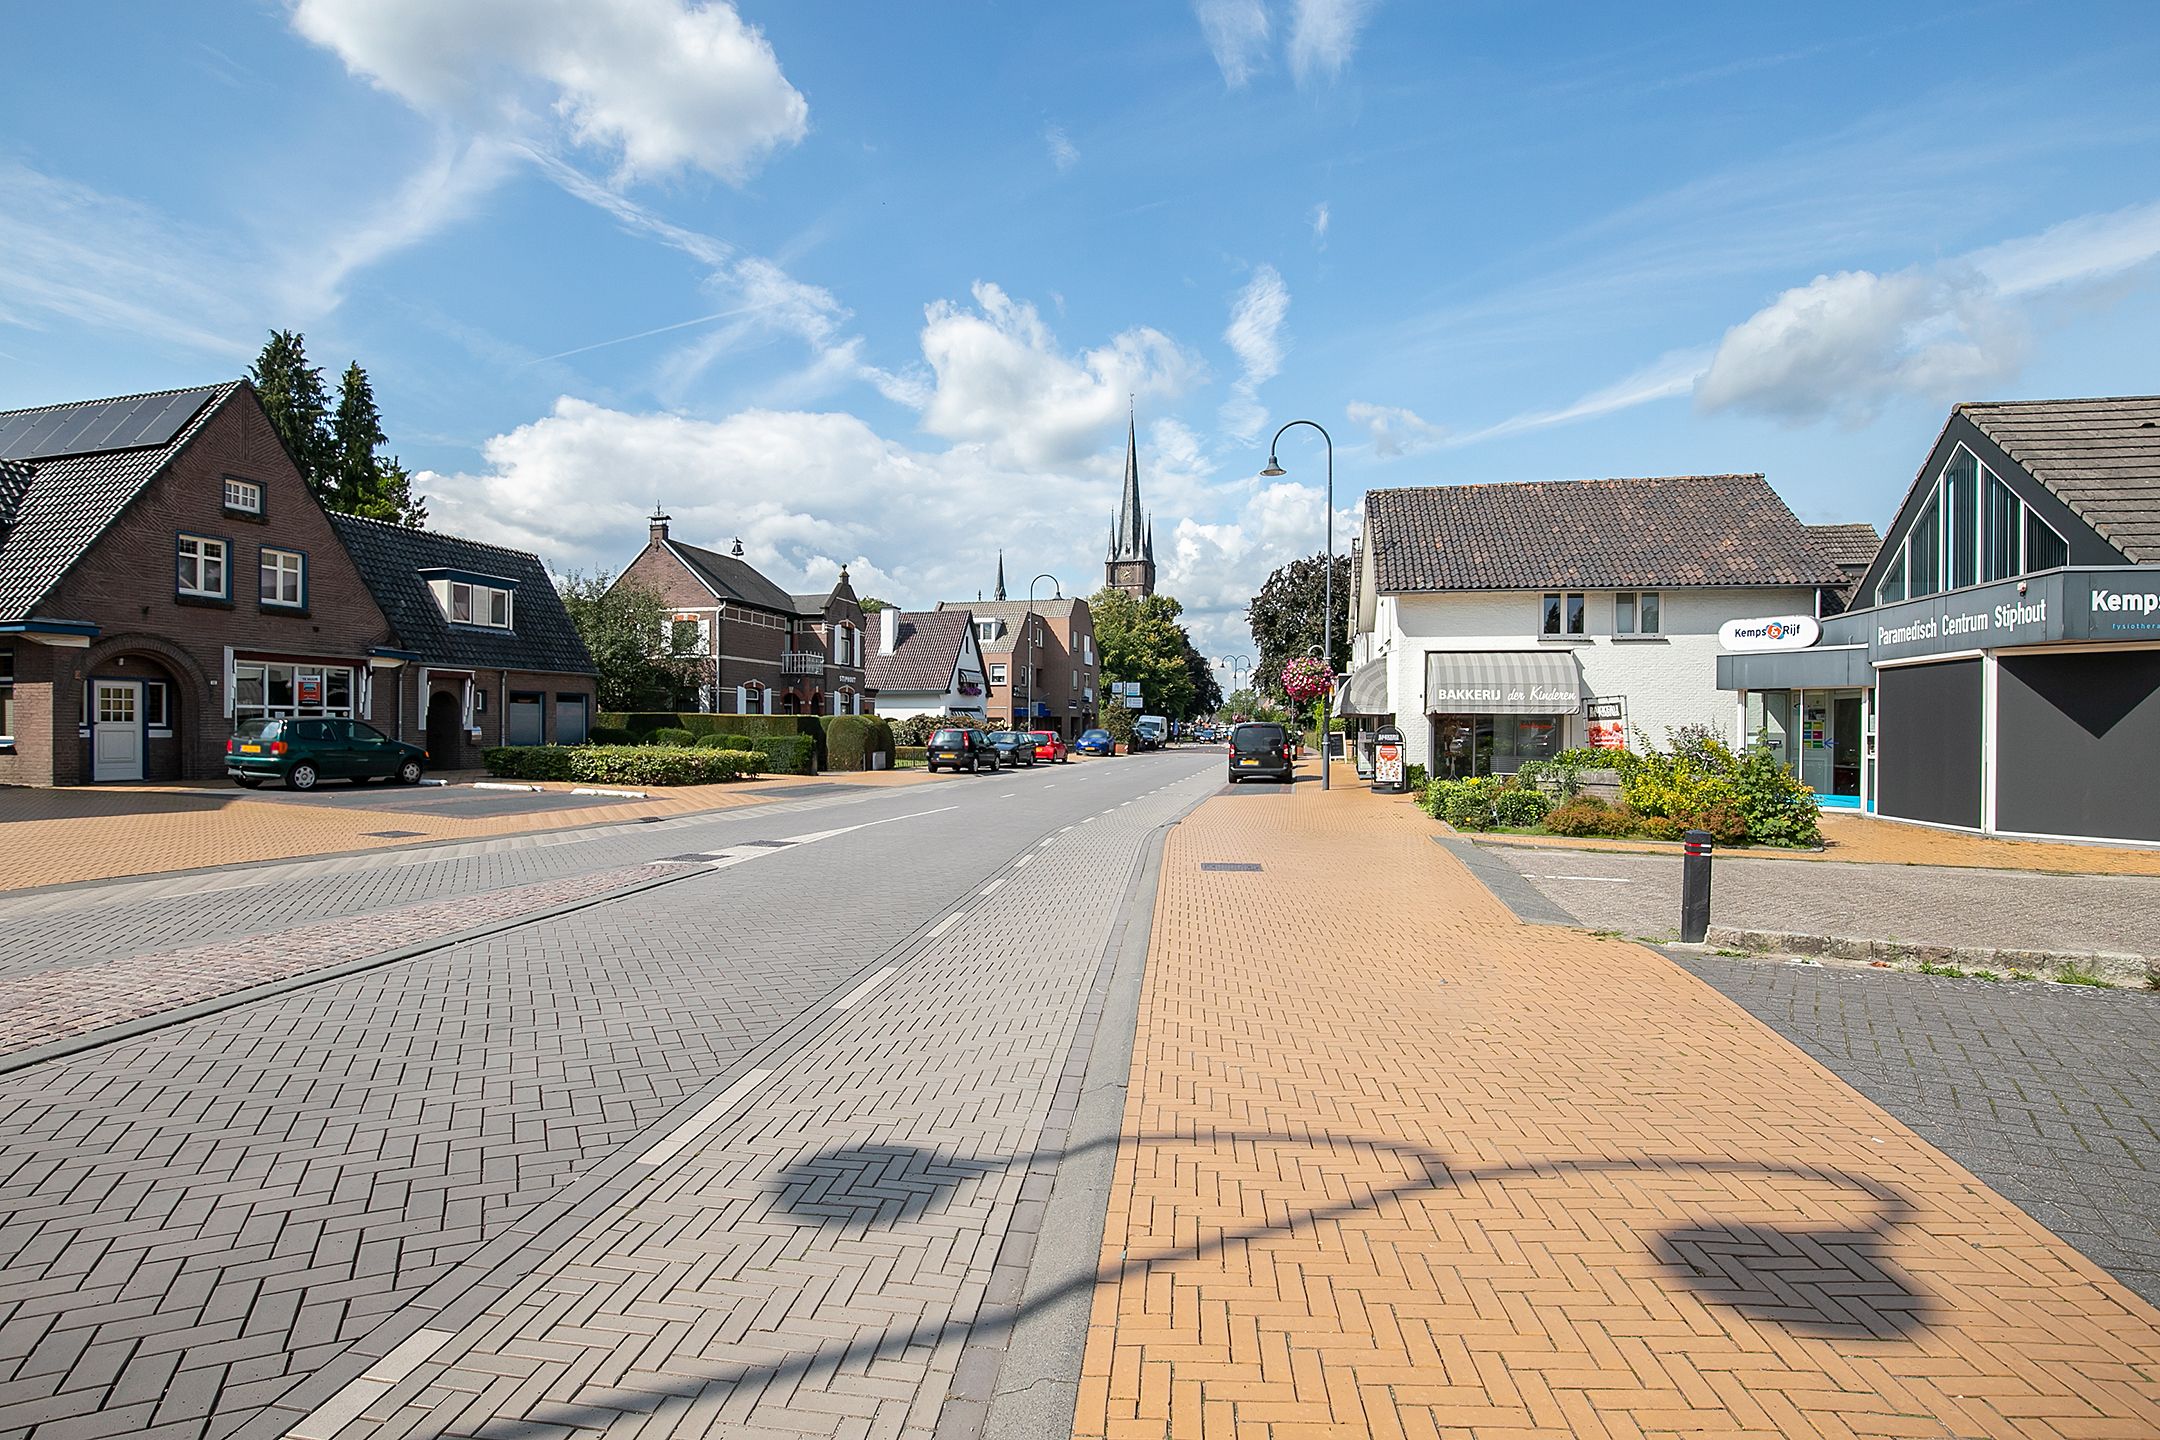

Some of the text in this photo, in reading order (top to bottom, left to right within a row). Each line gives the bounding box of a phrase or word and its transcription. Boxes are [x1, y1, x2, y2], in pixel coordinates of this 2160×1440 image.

[2091, 590, 2160, 616] Kemp
[1735, 628, 1767, 638] Kemps
[1783, 624, 1801, 636] Rijf
[1878, 599, 2047, 646] Paramedisch Centrum Stiphout
[1438, 685, 1577, 701] BAKKERIJ der Kinderen
